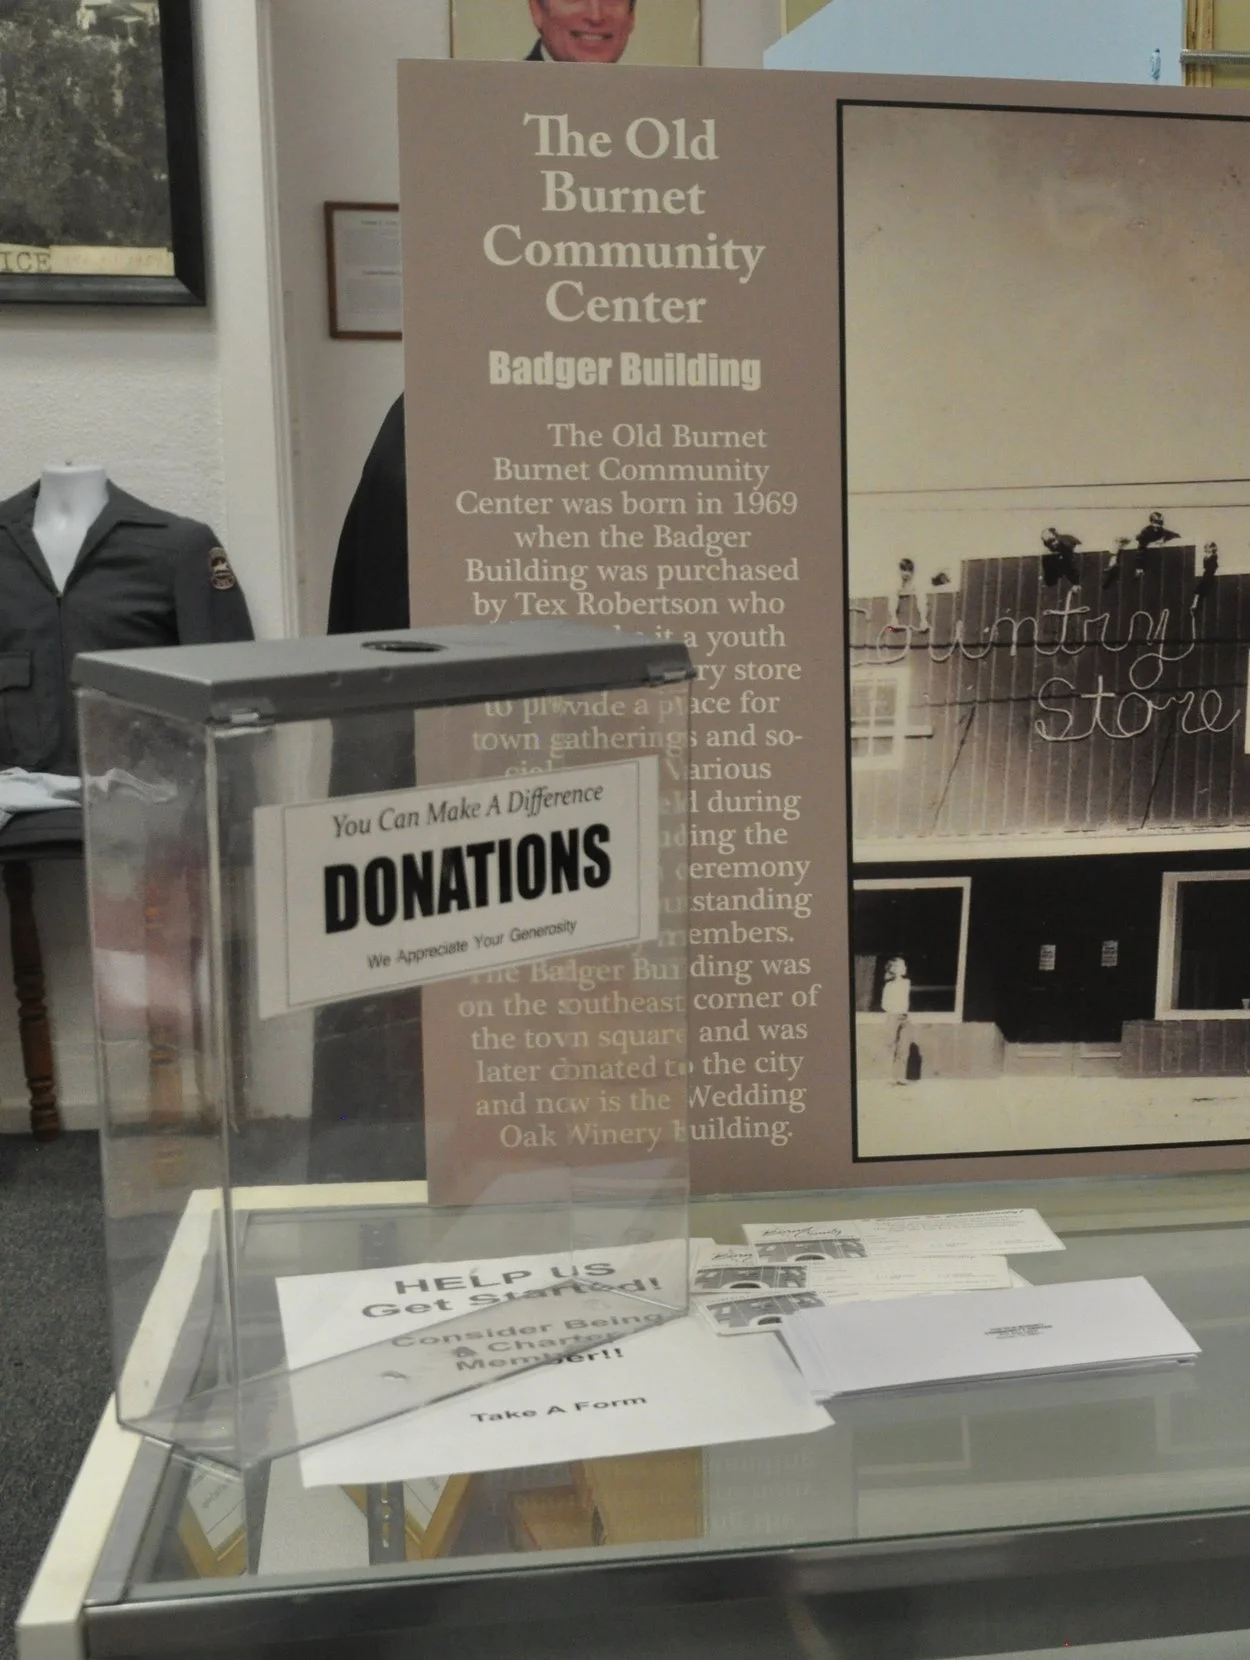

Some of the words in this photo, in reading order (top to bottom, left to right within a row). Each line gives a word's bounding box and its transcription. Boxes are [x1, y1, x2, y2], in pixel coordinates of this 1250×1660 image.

[524, 112, 612, 158] The
[625, 117, 719, 161] Old
[541, 169, 706, 215] Burnet
[483, 223, 765, 284] Community
[545, 280, 707, 324] Center
[489, 350, 612, 390] Badger
[619, 351, 761, 392] Building
[548, 423, 604, 448] The
[612, 424, 663, 448] Old
[672, 425, 767, 449] Burnet
[493, 457, 590, 481] Burnet
[599, 457, 770, 489] Community
[455, 491, 553, 515] Center
[561, 498, 615, 515] was
[622, 492, 688, 515] born
[696, 492, 724, 515] in
[733, 491, 797, 516] 1969
[514, 525, 590, 548] when
[599, 526, 644, 548] the
[653, 526, 751, 557] Badger
[465, 558, 588, 590] Building
[596, 564, 649, 582] was
[657, 557, 799, 589] purchased
[473, 592, 507, 624] by
[514, 592, 565, 616] Tex
[577, 592, 719, 616] Robertson
[728, 592, 785, 615] who
[683, 629, 698, 647] a
[706, 624, 786, 656] youth
[734, 662, 802, 681] store
[634, 697, 649, 716] a
[739, 691, 780, 714] for
[473, 731, 541, 751] town
[550, 725, 697, 759] gatherings
[706, 726, 757, 748] and
[765, 730, 804, 747] so-
[333, 814, 372, 839] You
[378, 806, 420, 832] Can
[426, 798, 481, 825] Make
[485, 795, 502, 816] A
[508, 783, 604, 818] Difference
[707, 790, 802, 821] during
[745, 822, 788, 846] the
[323, 822, 611, 934] DONATIONS
[367, 953, 391, 970] We
[395, 938, 469, 964] Appreciate
[474, 933, 505, 950] Your
[509, 919, 577, 943] Generosity
[531, 958, 625, 992] Badger
[761, 957, 812, 976] was
[458, 1000, 494, 1018] on
[504, 992, 547, 1016] the
[558, 990, 686, 1016] southeast
[694, 990, 783, 1010] corner
[791, 984, 819, 1008] of
[471, 1027, 516, 1050] the
[599, 1027, 687, 1054] square
[699, 1021, 751, 1043] and
[758, 1023, 808, 1040] was
[476, 1060, 541, 1083] later
[550, 1056, 657, 1082] donated
[702, 1053, 747, 1075] the
[754, 1051, 804, 1081] city
[476, 1091, 527, 1117] and
[600, 1090, 621, 1113] is
[630, 1088, 671, 1111] the
[687, 1085, 806, 1112] Wedding
[500, 1123, 558, 1148] Oak
[673, 1117, 793, 1147] building.
[395, 1271, 532, 1295] HELP
[550, 1262, 617, 1278] US
[362, 1298, 454, 1319] Get
[391, 1315, 553, 1349] Consider
[564, 1312, 663, 1330] Being
[471, 1408, 537, 1423] Take
[547, 1405, 567, 1415] A
[574, 1395, 647, 1412] Form
